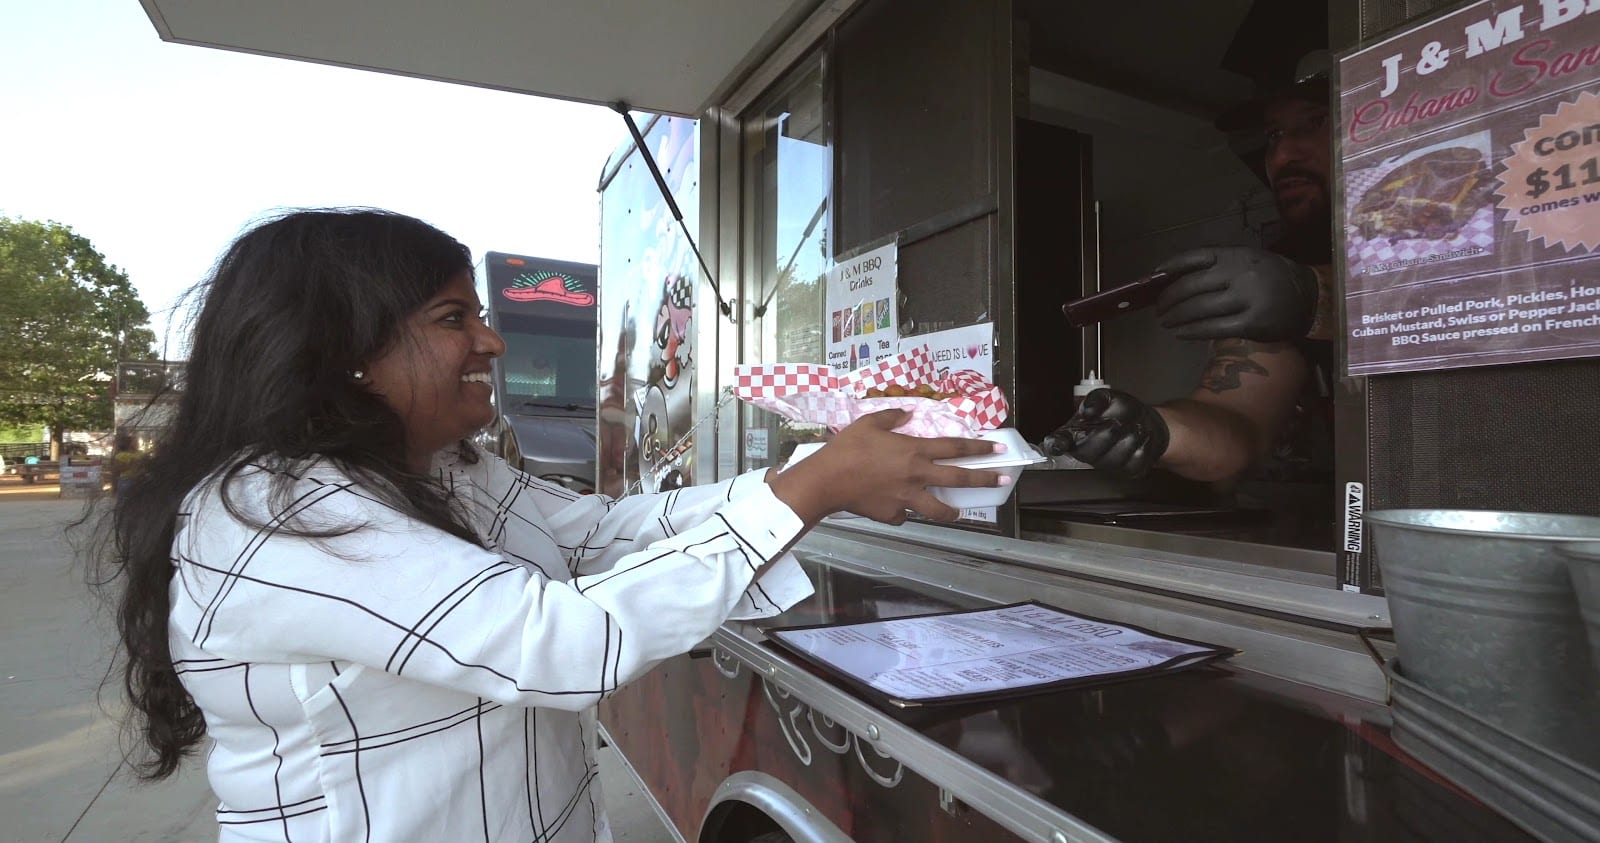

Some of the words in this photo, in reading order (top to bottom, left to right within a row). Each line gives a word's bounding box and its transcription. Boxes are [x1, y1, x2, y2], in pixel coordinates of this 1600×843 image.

[1381, 53, 1402, 98] J
[1416, 41, 1450, 75] &
[1465, 5, 1524, 59] M
[1540, 0, 1600, 31] B
[1350, 86, 1481, 143] Cubano
[1526, 158, 1600, 199] $11
[1520, 196, 1580, 215] comes
[852, 264, 861, 276] M
[863, 256, 882, 273] BBQ
[1427, 246, 1479, 263] Sandwich
[849, 275, 873, 292] Drinks
[1352, 326, 1388, 338] Cuban
[1390, 318, 1446, 333] Mustard,
[1448, 314, 1486, 327] Swiss
[1488, 311, 1506, 321] or
[1508, 305, 1565, 320] Pepper
[1361, 311, 1404, 324] Brisket
[1405, 309, 1420, 318] or
[1421, 302, 1462, 316] Pulled
[1465, 298, 1504, 311] Pork,
[1507, 290, 1568, 306] Pickles,
[1392, 335, 1420, 346] BBQ
[1421, 332, 1460, 343] Sauce
[1463, 323, 1519, 340] pressed
[1521, 323, 1542, 333] on
[1545, 314, 1600, 331] French
[828, 349, 847, 360] Canned
[877, 340, 890, 350] Tea
[953, 348, 961, 360] IS
[1346, 505, 1361, 552] WARNING
